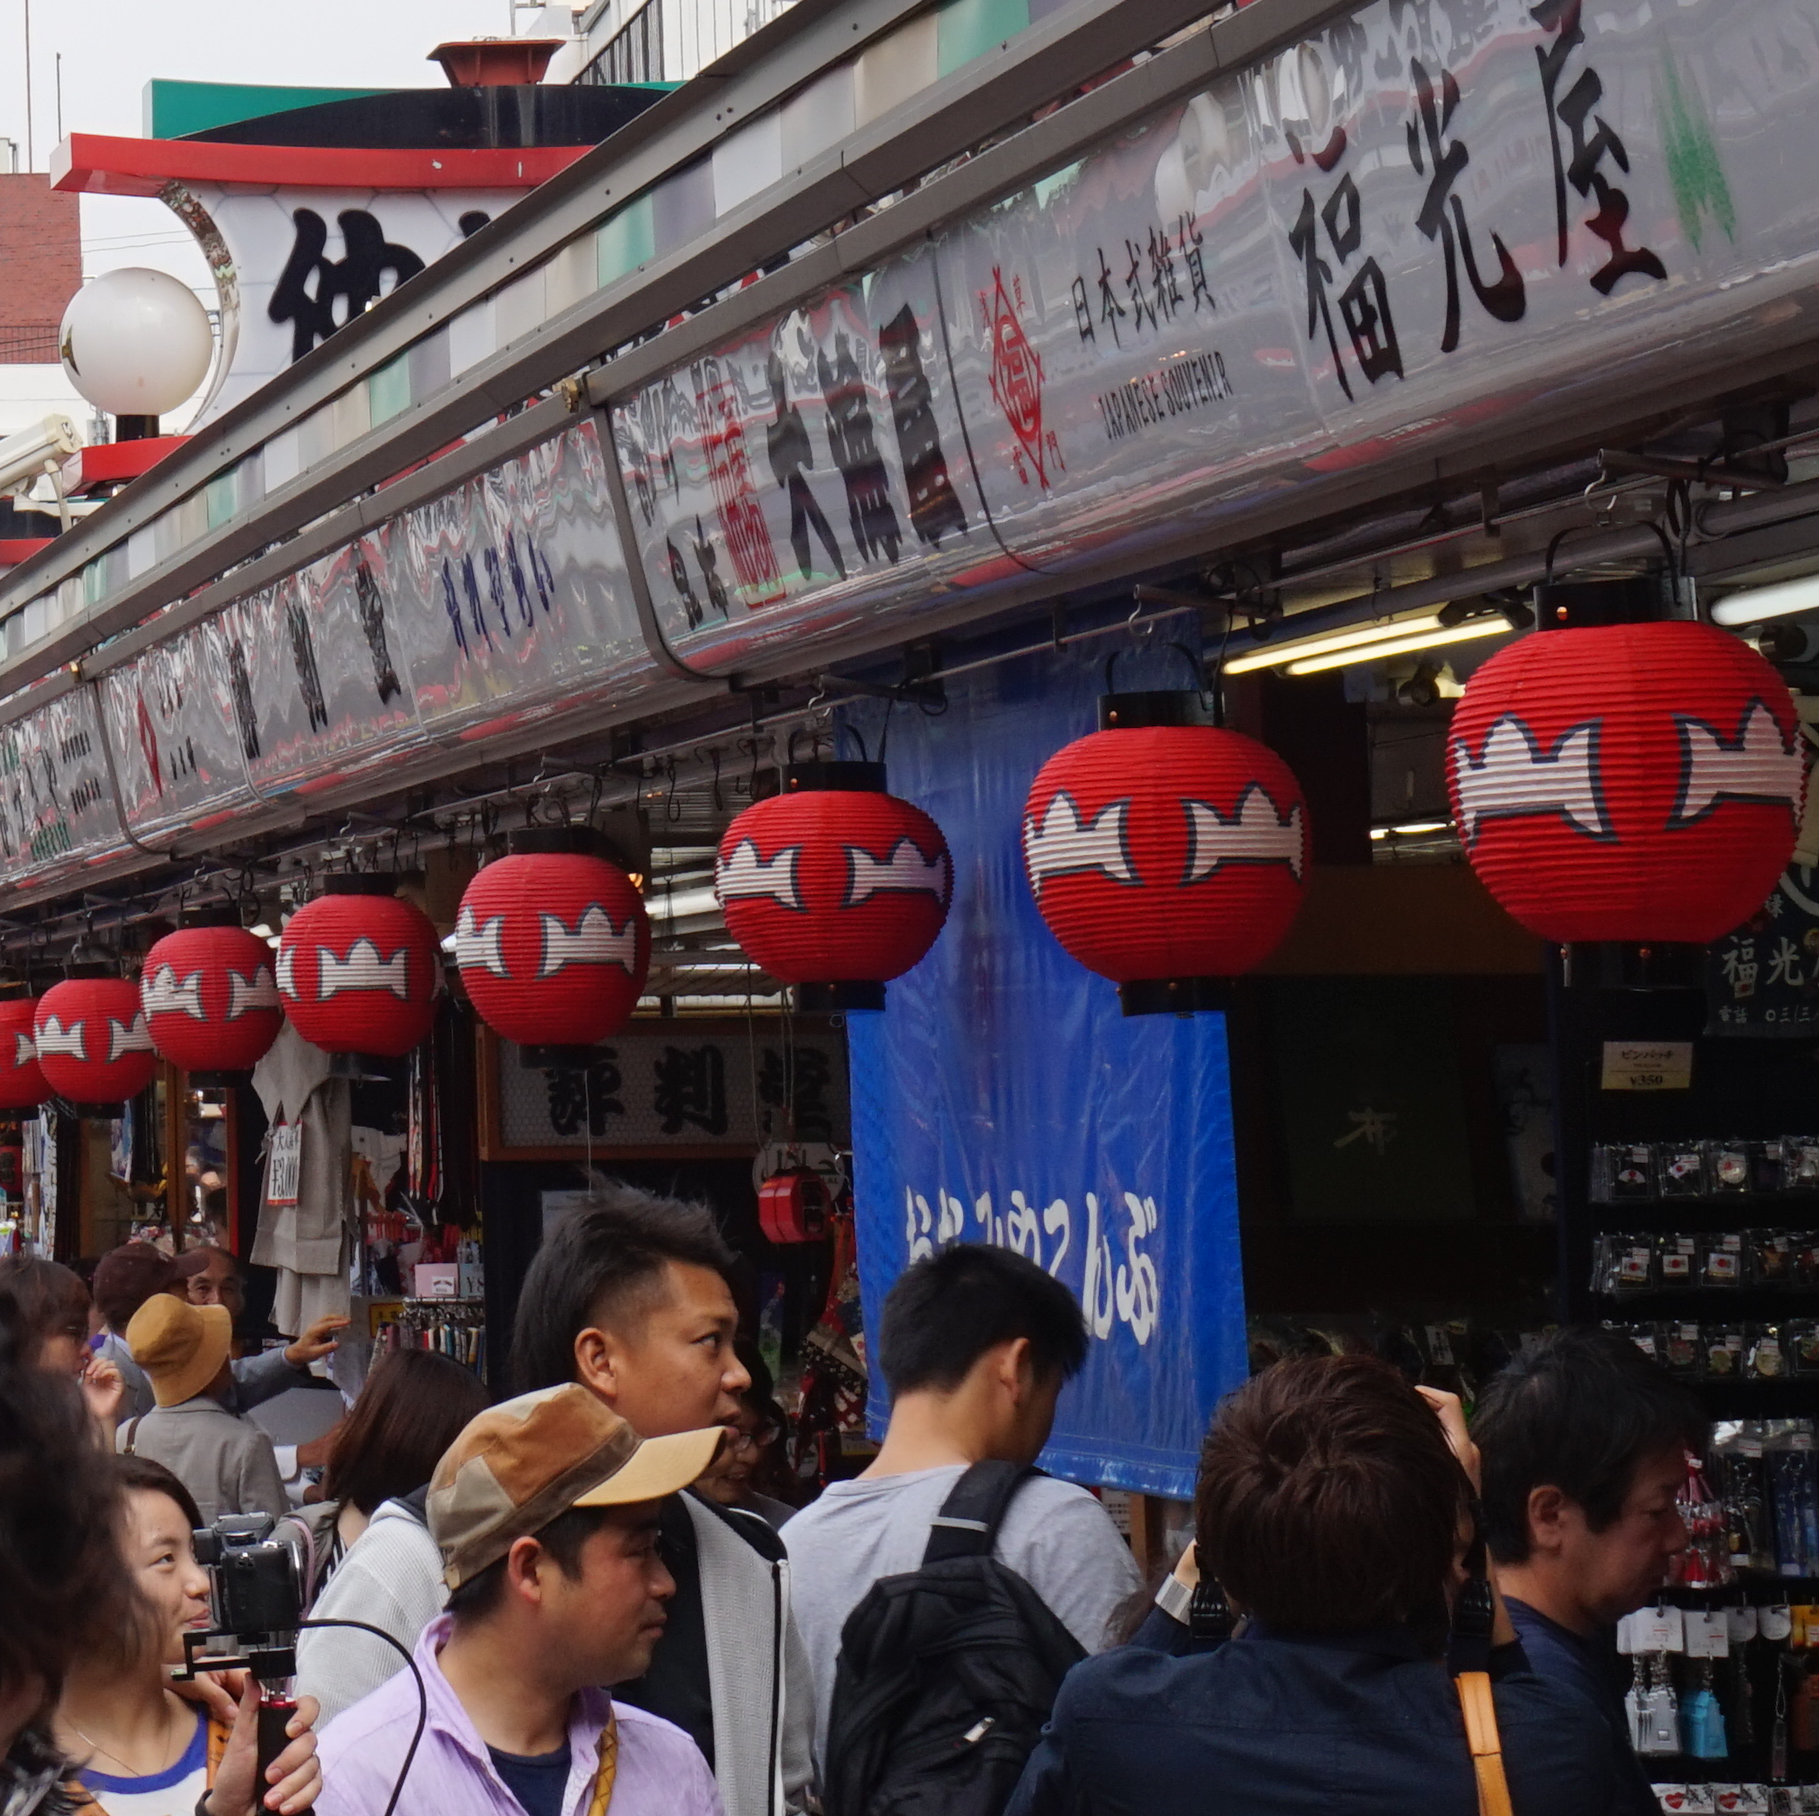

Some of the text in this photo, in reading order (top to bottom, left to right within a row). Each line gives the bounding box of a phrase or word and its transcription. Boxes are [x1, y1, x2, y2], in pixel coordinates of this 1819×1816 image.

[1068, 206, 1218, 350] 日本式雑貨
[1096, 350, 1234, 441] JAPANESE SOUVENIR
[1720, 934, 1819, 987] 福光
